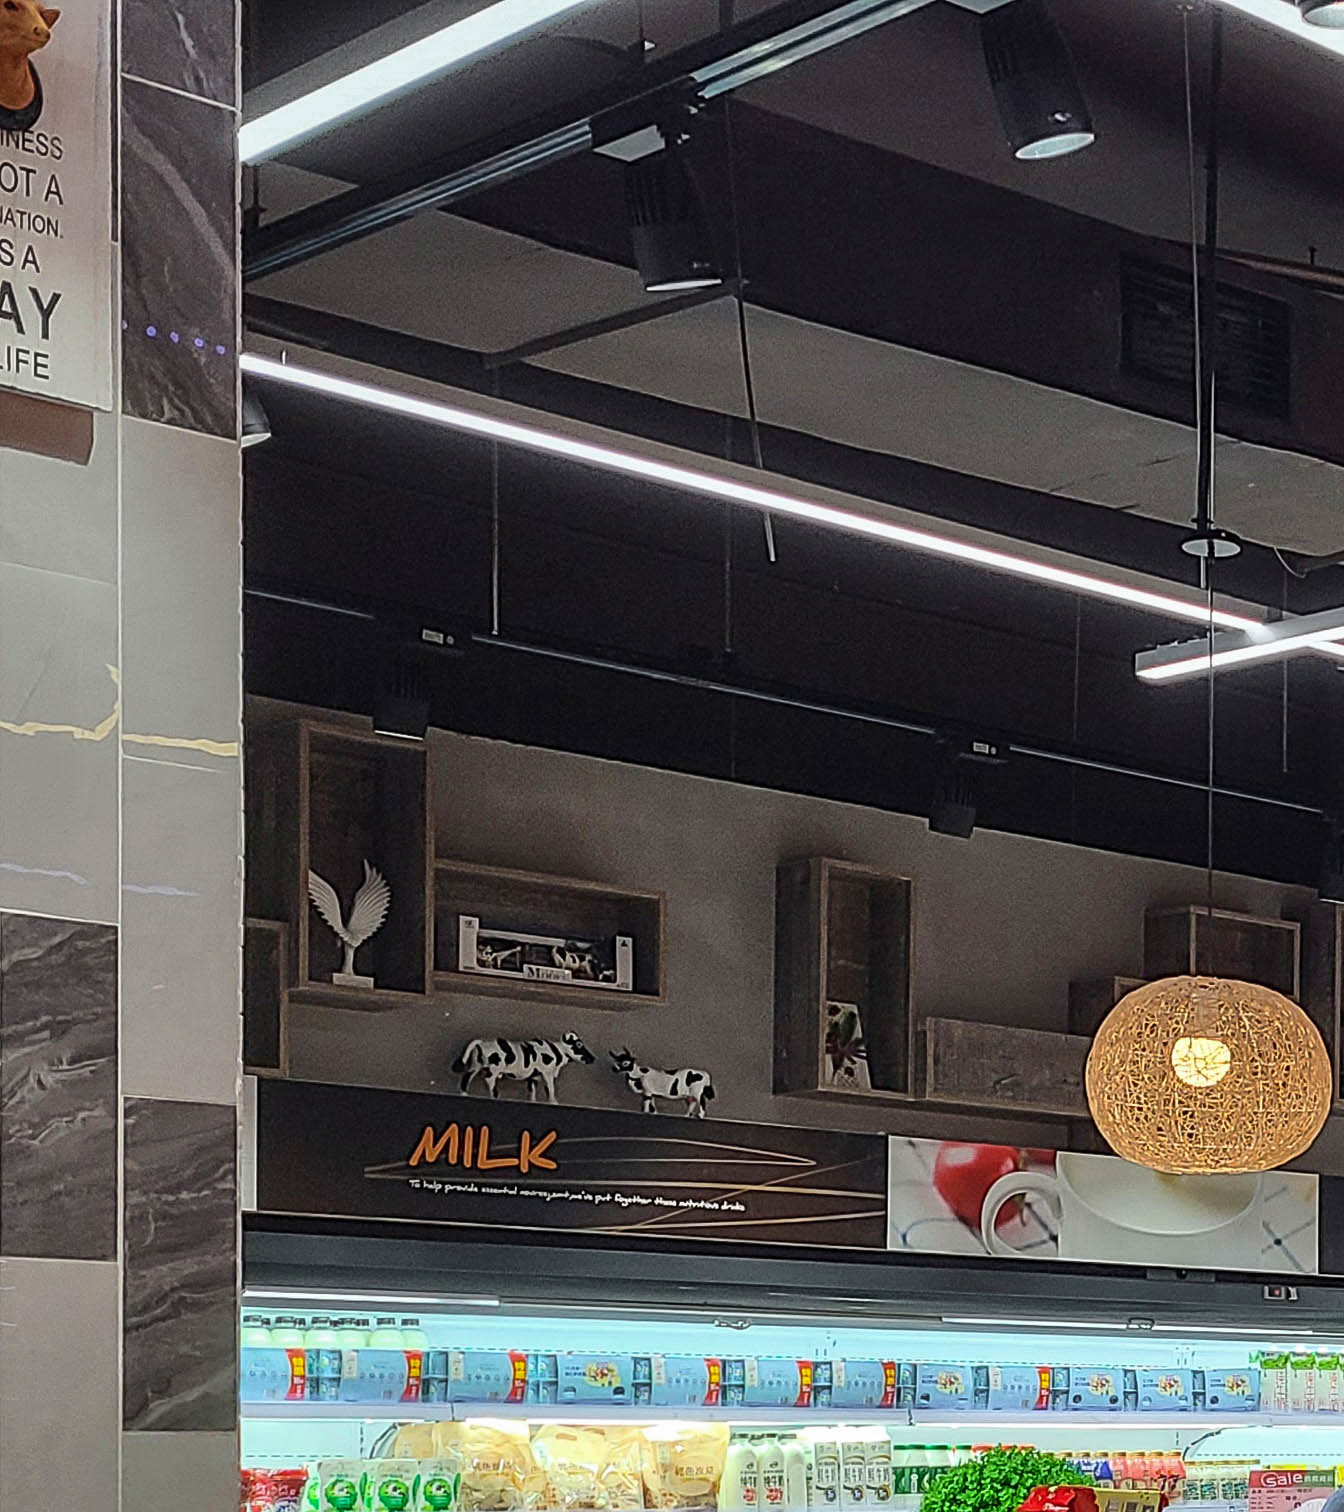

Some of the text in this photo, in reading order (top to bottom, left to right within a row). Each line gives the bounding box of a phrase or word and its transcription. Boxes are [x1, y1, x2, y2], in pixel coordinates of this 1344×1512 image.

[44, 174, 63, 205] A
[21, 245, 40, 273] A
[408, 1123, 559, 1174] MILK
[1261, 1472, 1304, 1488] Sale
